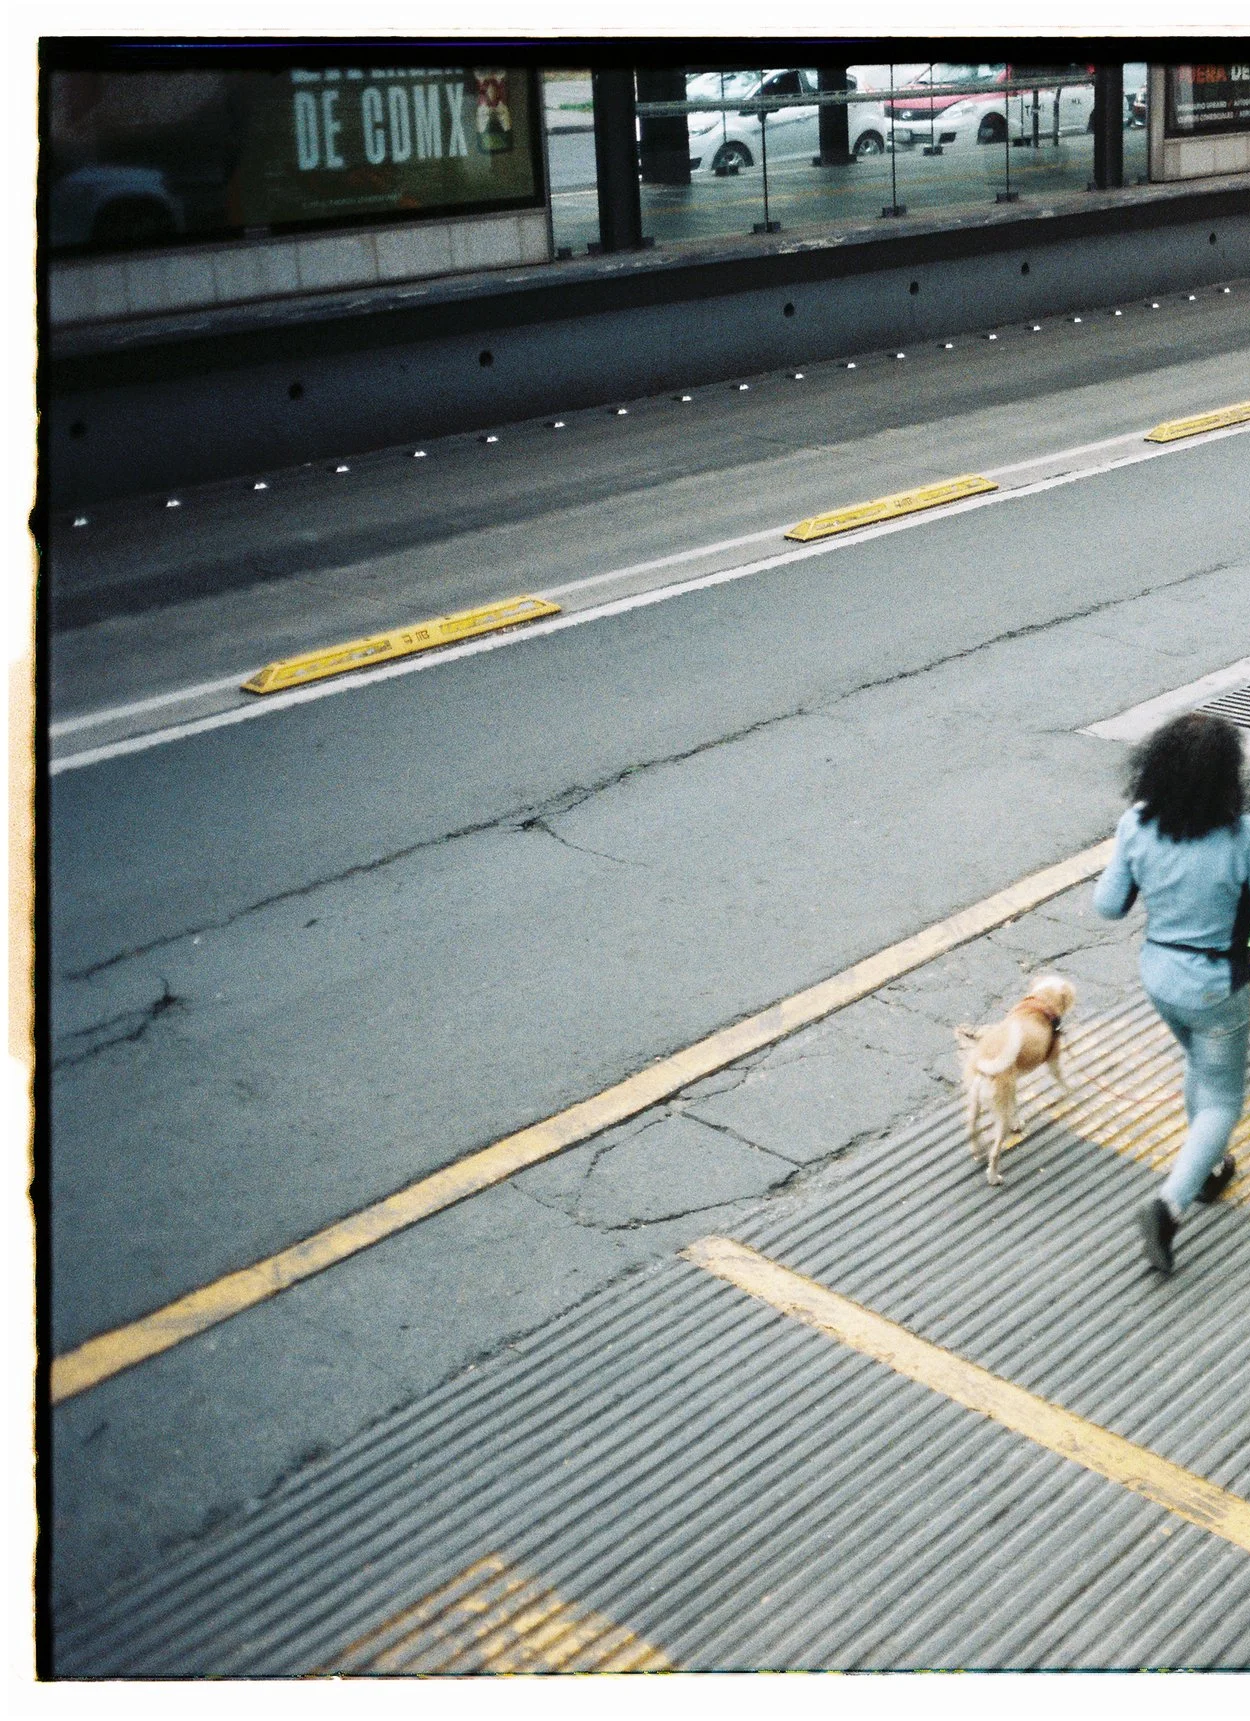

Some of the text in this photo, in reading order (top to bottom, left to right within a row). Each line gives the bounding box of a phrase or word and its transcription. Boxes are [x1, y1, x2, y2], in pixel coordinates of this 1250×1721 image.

[1231, 64, 1250, 80] DE
[294, 82, 468, 171] DE CDMX
